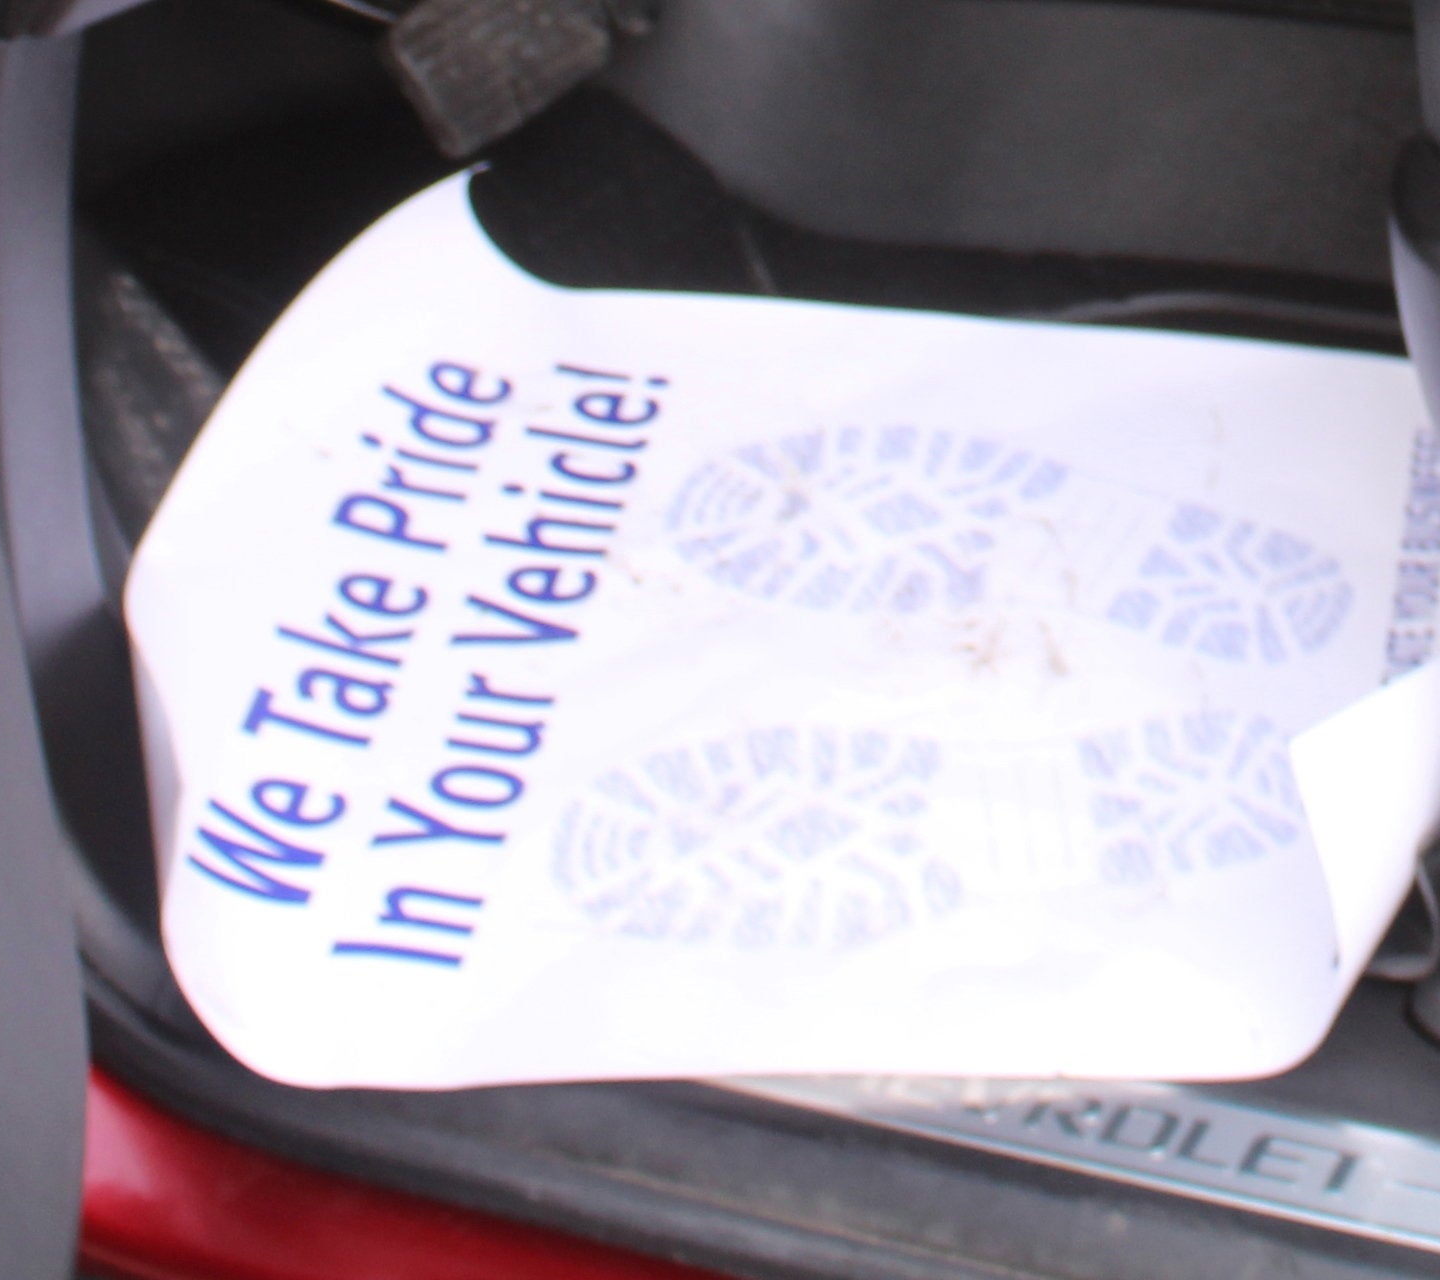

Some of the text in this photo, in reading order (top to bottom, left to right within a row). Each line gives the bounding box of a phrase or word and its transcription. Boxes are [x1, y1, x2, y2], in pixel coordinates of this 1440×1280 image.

[185, 360, 513, 906] We Take Pride
[330, 362, 668, 968] In Your Vehicle!
